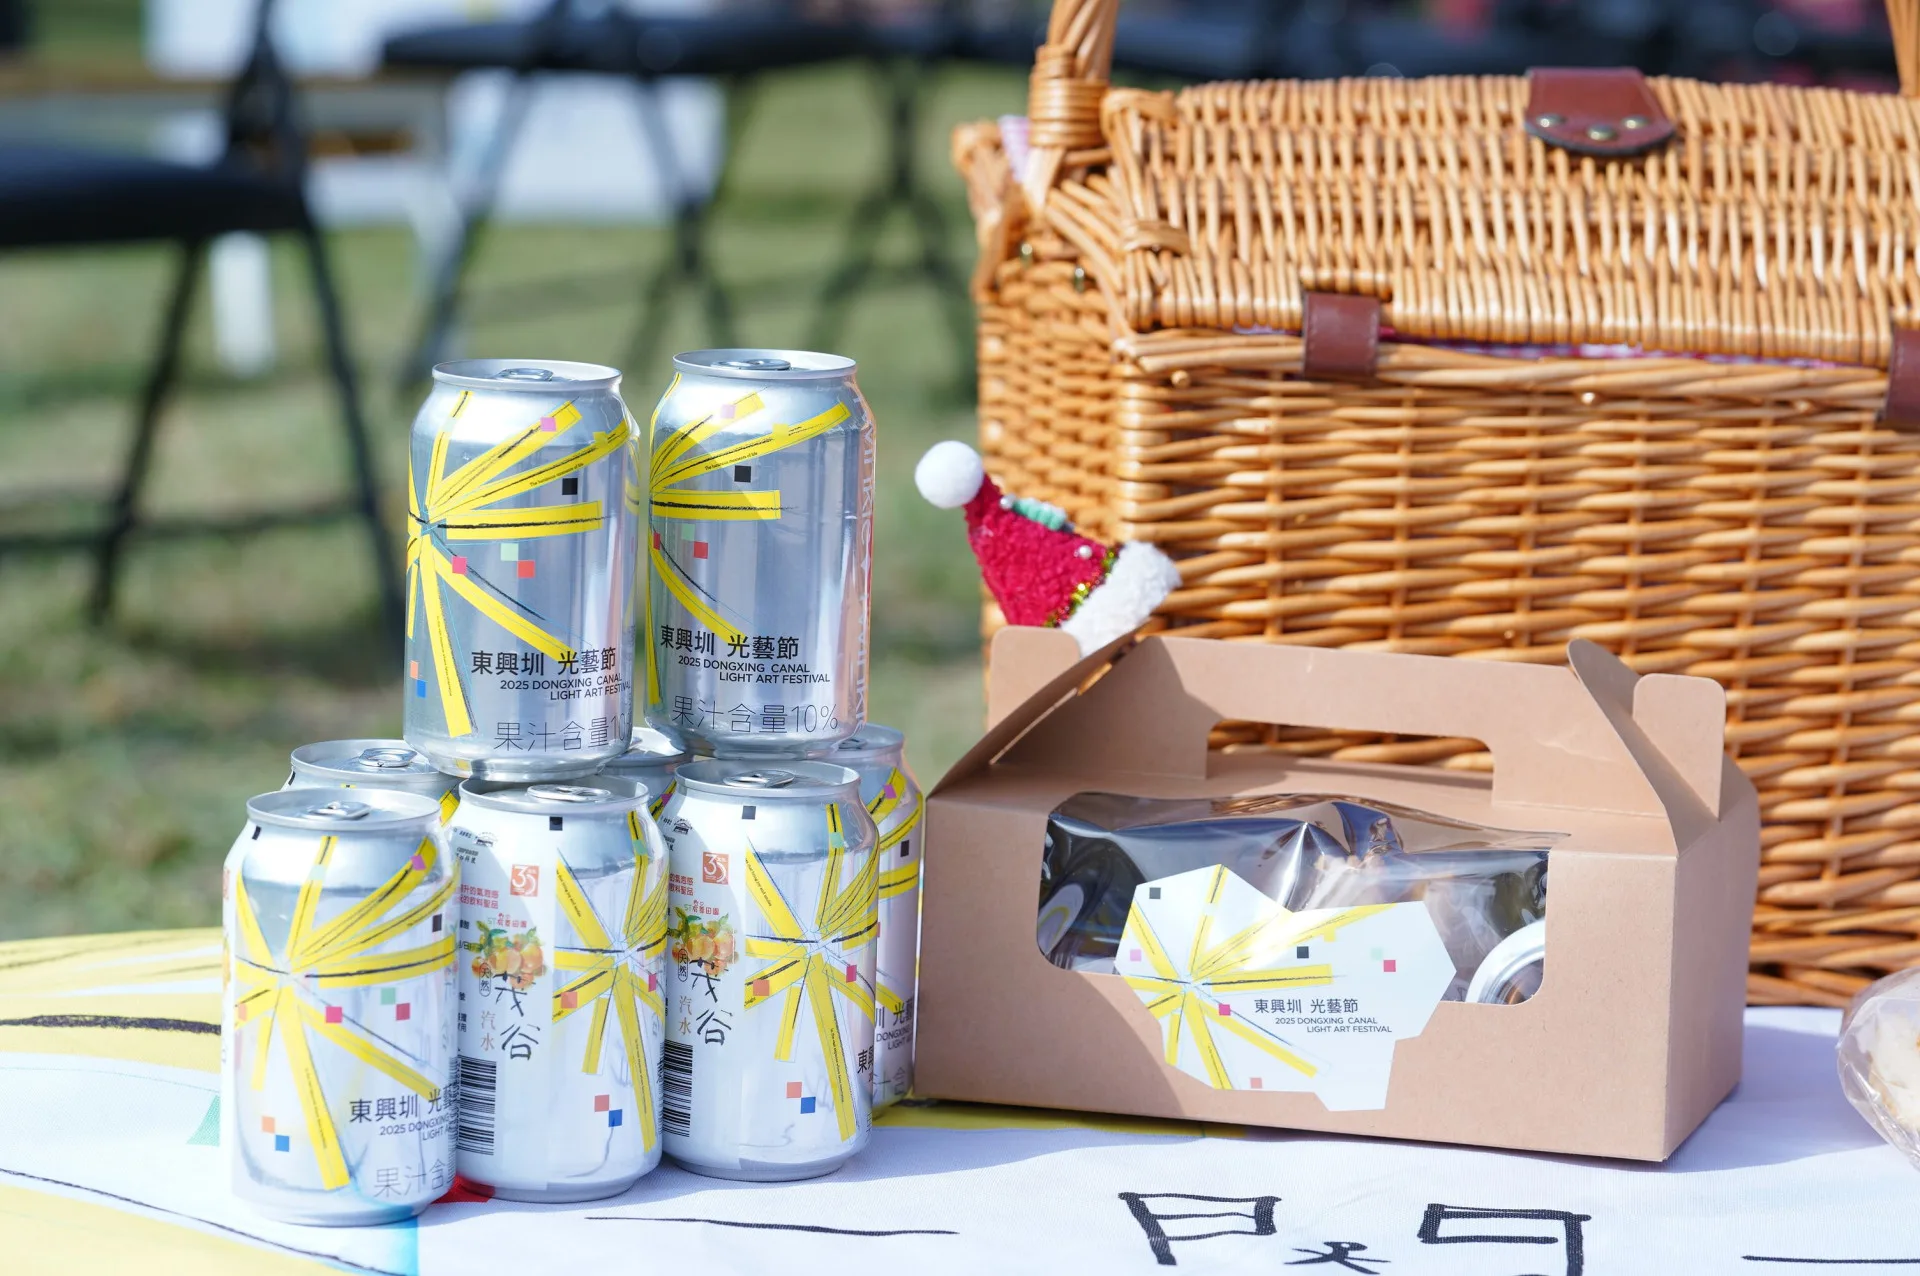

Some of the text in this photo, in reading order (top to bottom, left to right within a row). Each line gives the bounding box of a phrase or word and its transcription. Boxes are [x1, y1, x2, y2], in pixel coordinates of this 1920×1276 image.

[661, 625, 799, 660] 東興圳 光藝節
[471, 647, 616, 676] 東興圳 光藝節
[678, 655, 810, 673] 2025 DONGXING CANAL
[500, 673, 623, 690] 2025 DONGXING CANAL
[719, 672, 831, 684] LIGHT ART FESTIVAL
[550, 690, 580, 701] LIGHT
[584, 687, 602, 698] ART
[672, 695, 838, 734] 果汁含量10%
[1254, 998, 1359, 1014] 東興圳 光藝節
[679, 995, 692, 1036] 汽水
[1275, 1017, 1378, 1025] 2025 DONGXING CANAL
[480, 1010, 496, 1052] 汽水
[1307, 1025, 1393, 1033] LIGHT ART FESTIVAL
[349, 1094, 418, 1123] 東興圳
[380, 1124, 406, 1136] 2025
